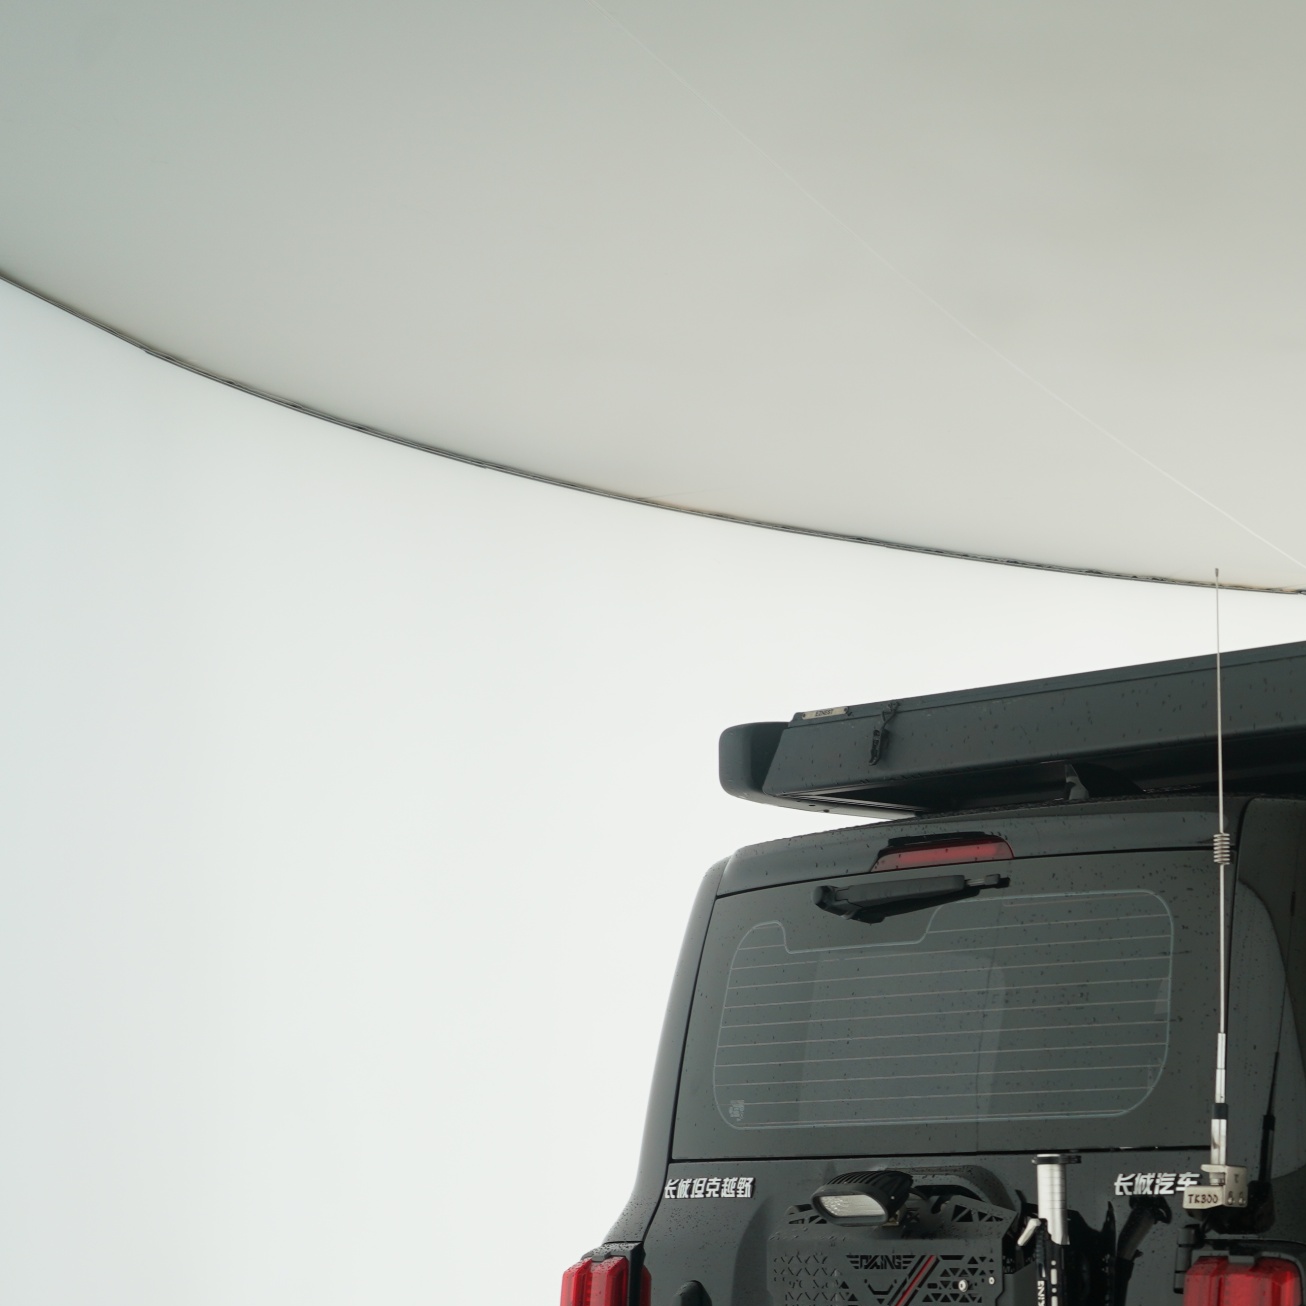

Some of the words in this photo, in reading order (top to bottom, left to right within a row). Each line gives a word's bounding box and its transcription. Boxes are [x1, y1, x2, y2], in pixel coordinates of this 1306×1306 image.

[664, 1177, 754, 1199] 长城坦克越野
[1114, 1171, 1200, 1196] 长城汽车
[1187, 1193, 1219, 1204] TK300
